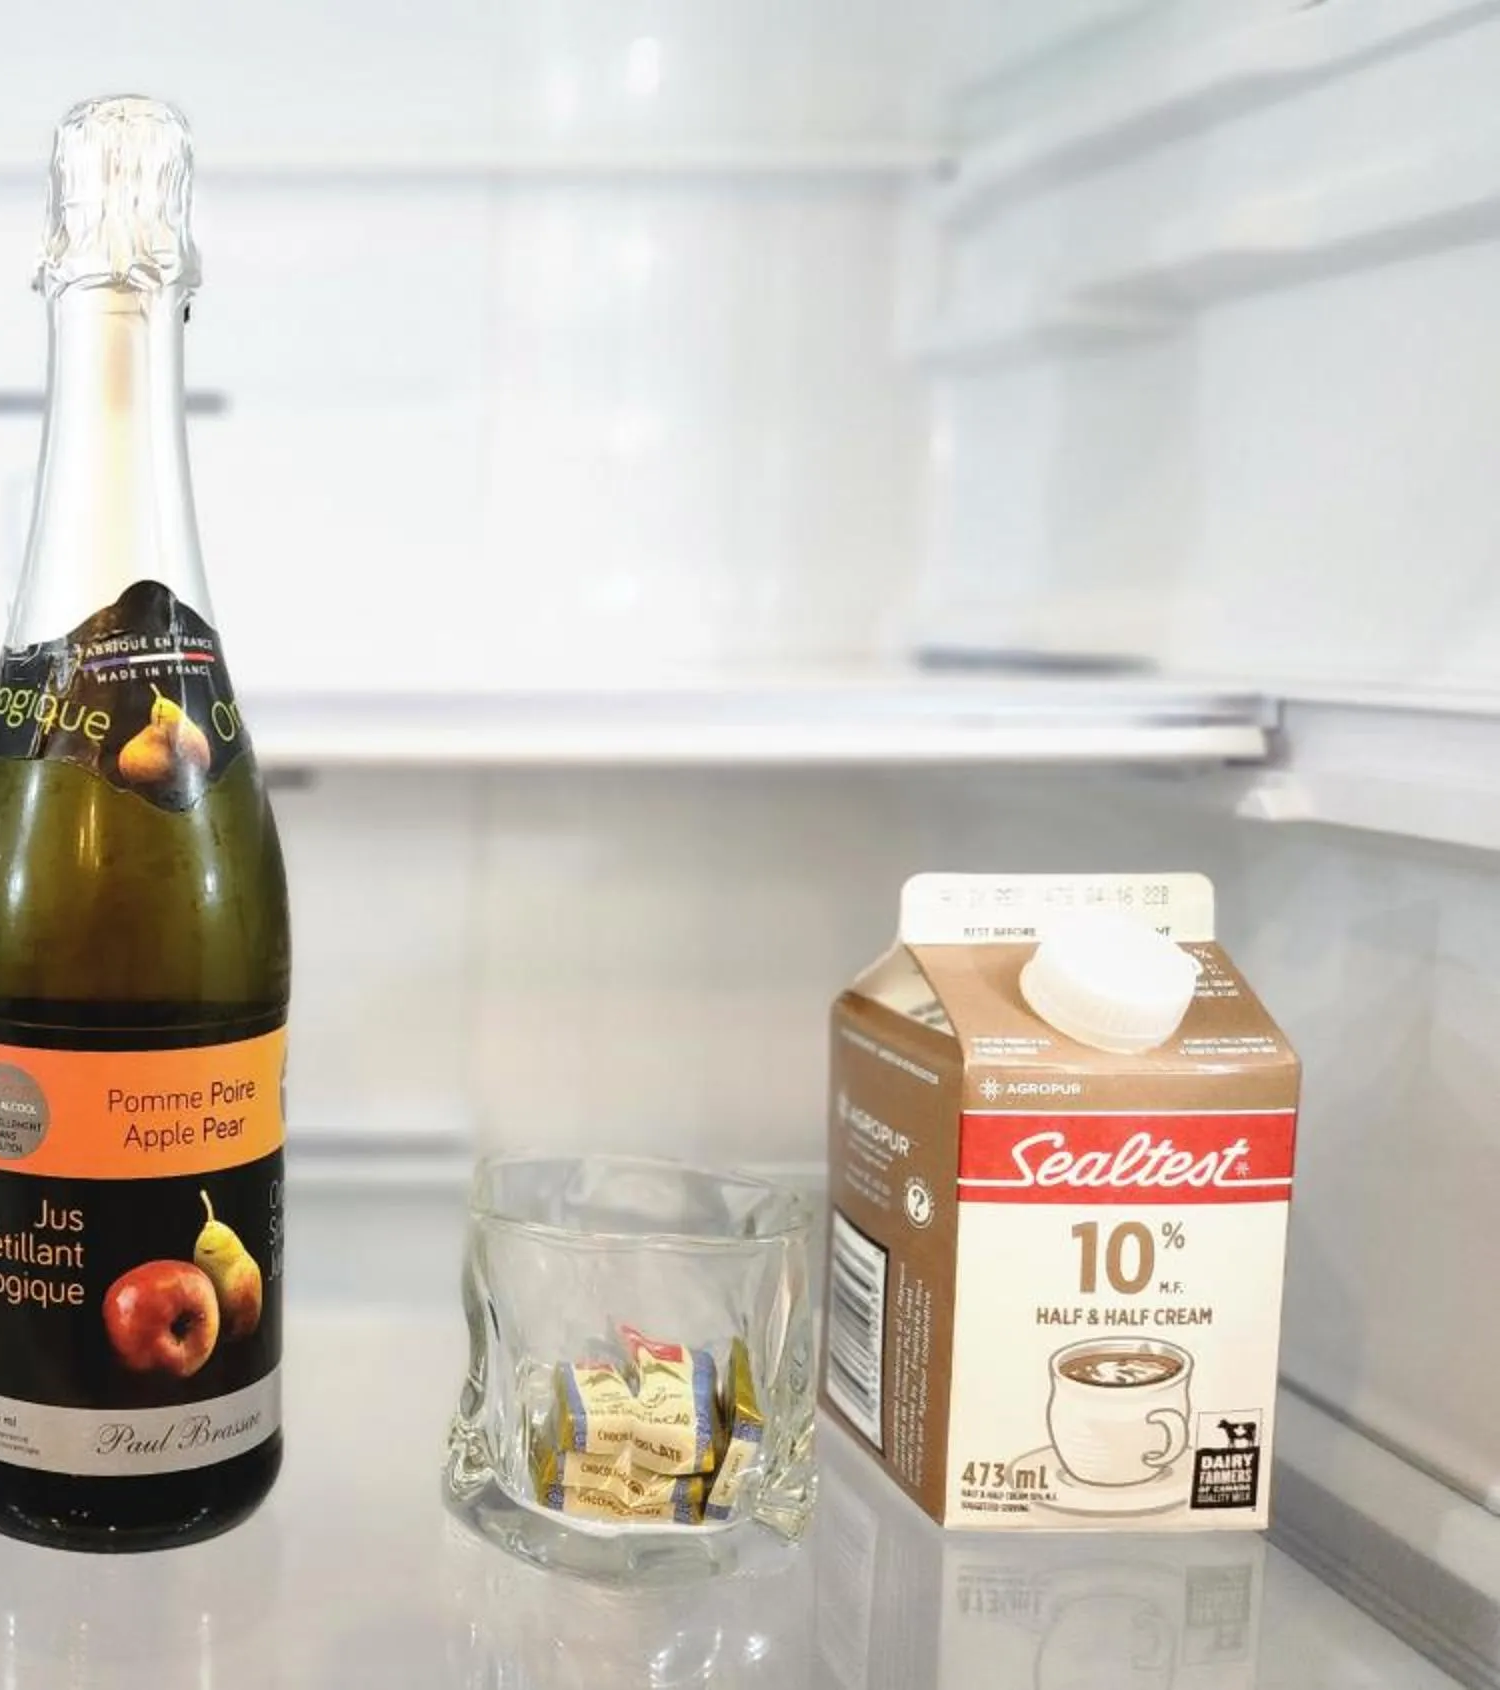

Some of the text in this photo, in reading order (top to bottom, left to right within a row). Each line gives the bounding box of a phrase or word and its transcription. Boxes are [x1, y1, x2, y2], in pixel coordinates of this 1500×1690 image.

[97, 669, 138, 684] MADE
[107, 1079, 256, 1113] Pomme Poire
[1006, 1083, 1082, 1096] AGROPUR
[123, 1116, 246, 1152] Apple Pear
[1011, 1131, 1251, 1187] Sealtest
[33, 1199, 84, 1232] Jus
[1036, 1307, 1213, 1326] HALF & HALF CREAM
[96, 1417, 176, 1456] Paul
[961, 1461, 1049, 1490] 473 mL
[1201, 1453, 1254, 1469] DAIRY
[1199, 1468, 1252, 1485] FARMERS
